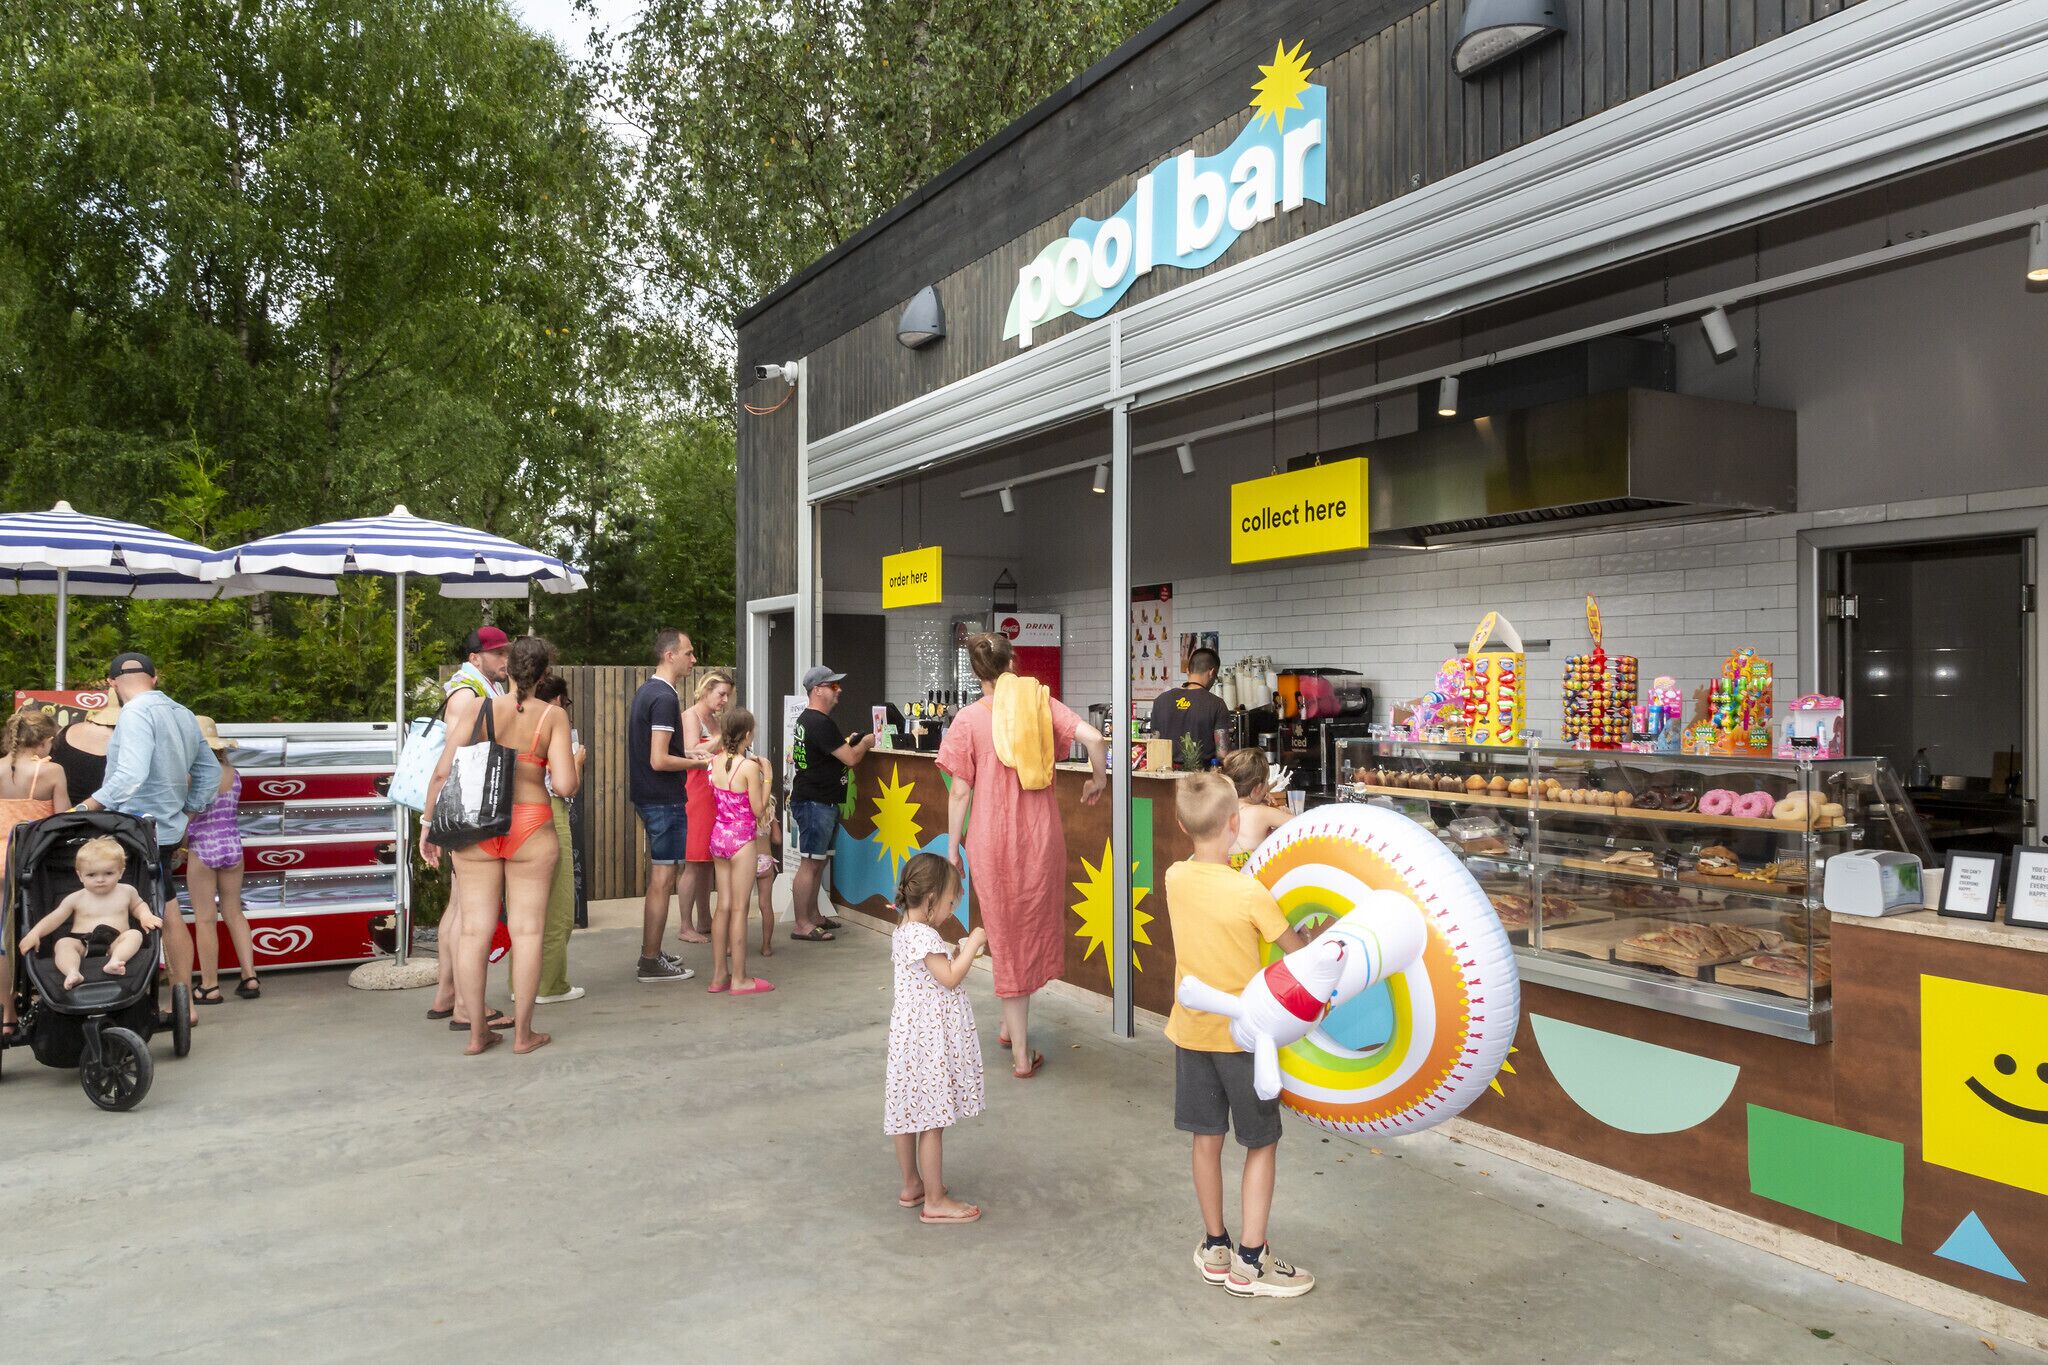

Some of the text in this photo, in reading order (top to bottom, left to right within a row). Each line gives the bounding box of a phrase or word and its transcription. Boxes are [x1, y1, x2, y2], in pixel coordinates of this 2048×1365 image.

[1019, 118, 1321, 349] pool bar
[1241, 499, 1347, 533] collect here
[889, 570, 928, 588] order here
[1025, 622, 1055, 630] DRINK
[1291, 736, 1307, 747] iced
